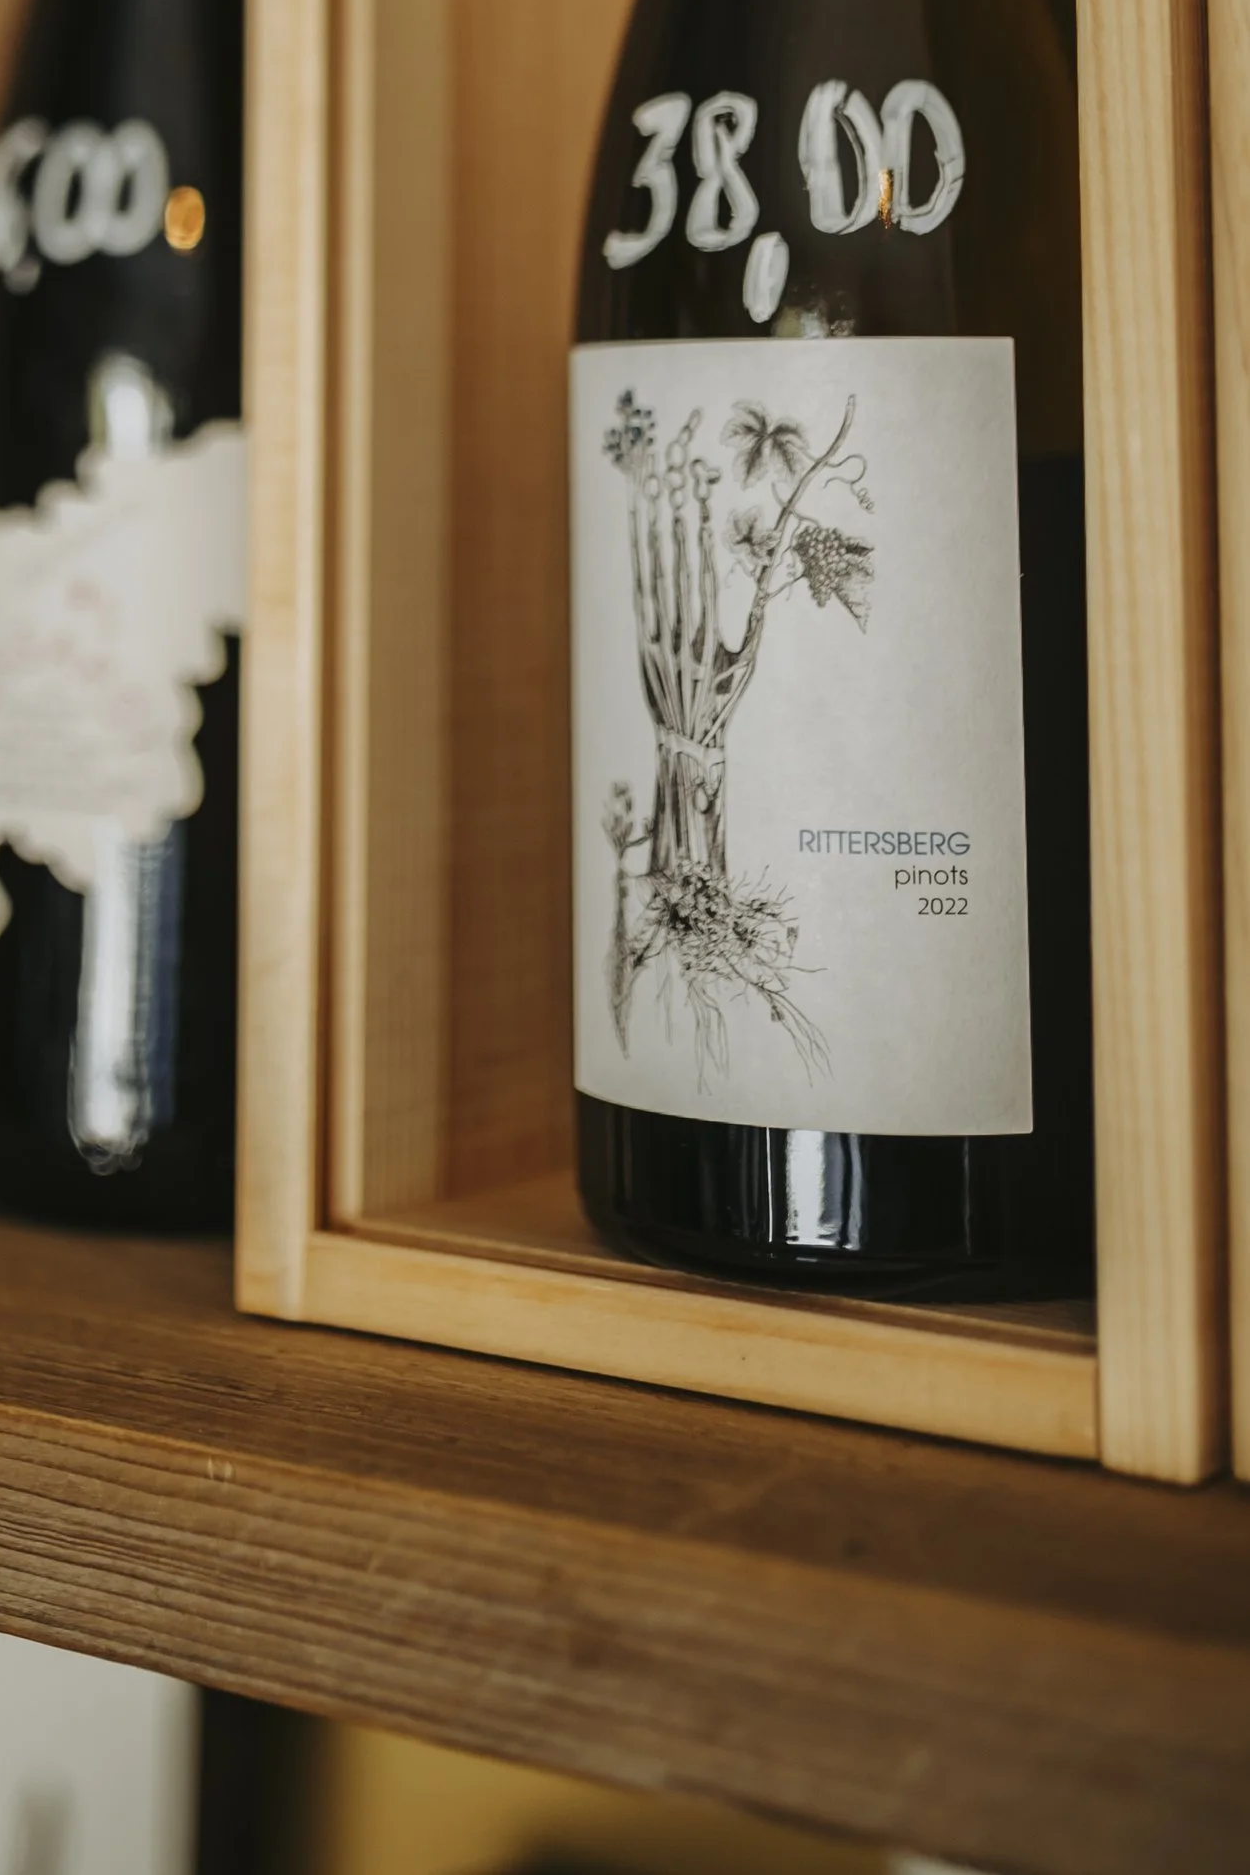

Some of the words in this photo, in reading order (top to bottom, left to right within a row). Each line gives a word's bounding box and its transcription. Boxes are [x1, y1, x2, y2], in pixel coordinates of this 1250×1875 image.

[799, 829, 971, 856] RITTERSBERG
[894, 865, 969, 890] pinots
[918, 897, 969, 915] 2022
